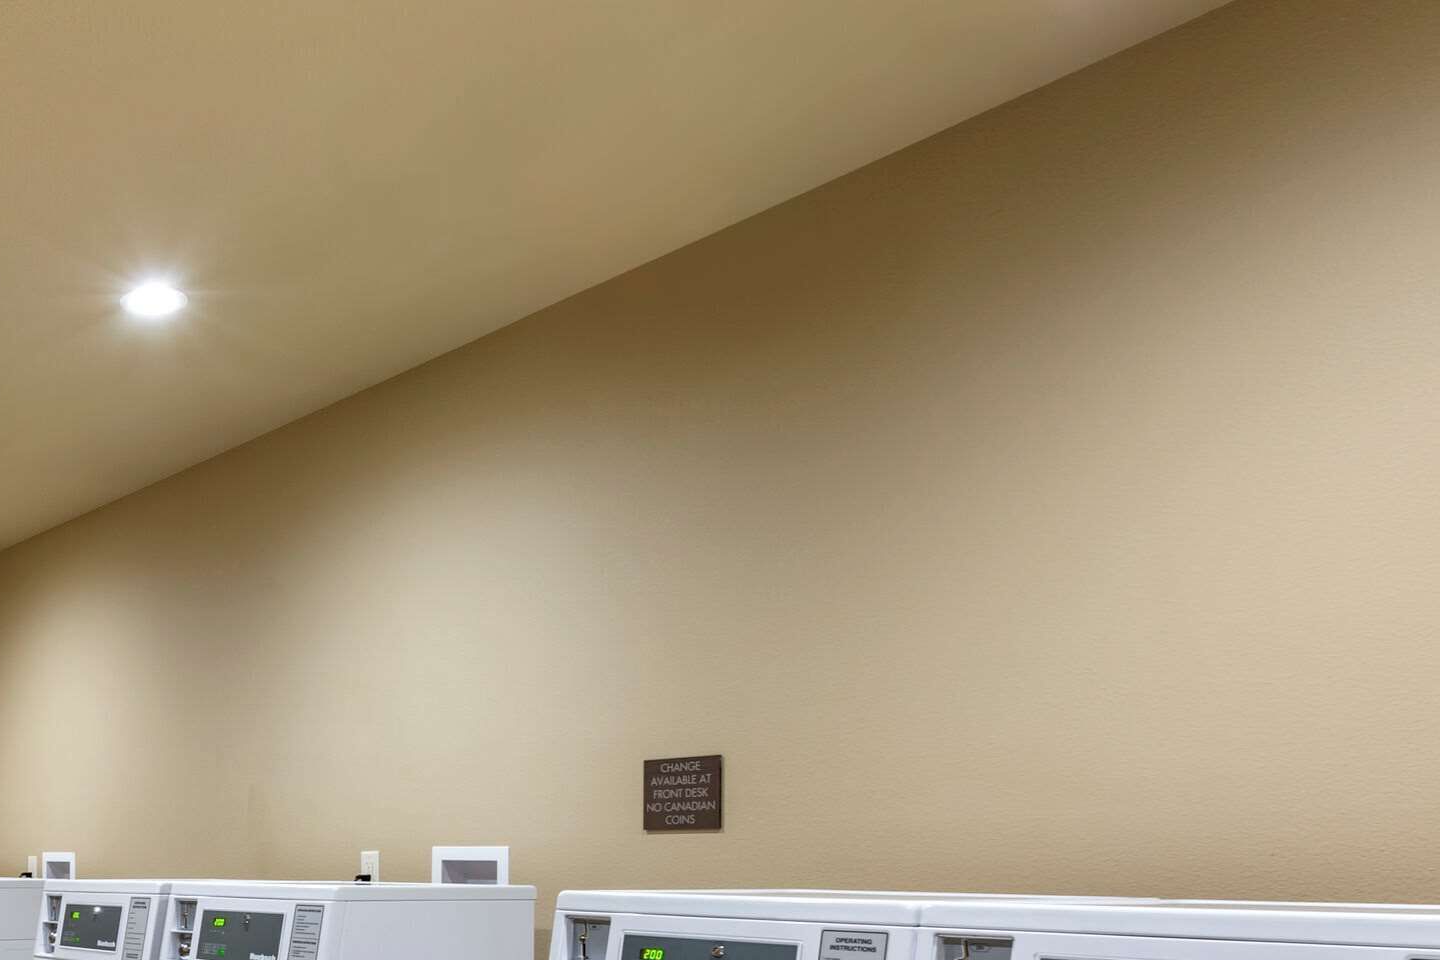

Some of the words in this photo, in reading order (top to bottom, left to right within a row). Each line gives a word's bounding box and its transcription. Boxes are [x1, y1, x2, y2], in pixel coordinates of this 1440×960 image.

[660, 760, 701, 773] CHANGE
[650, 775, 697, 786] AVAILABLE
[699, 773, 712, 784] AT
[653, 788, 683, 800] FRONT
[685, 787, 709, 797] DESK
[647, 803, 662, 813] NO
[664, 800, 716, 812] CANADIAN
[664, 815, 696, 825] COINS
[835, 937, 872, 945] OPERATING
[642, 948, 664, 960] 200
[829, 944, 877, 953] INSTRUCTIONS
